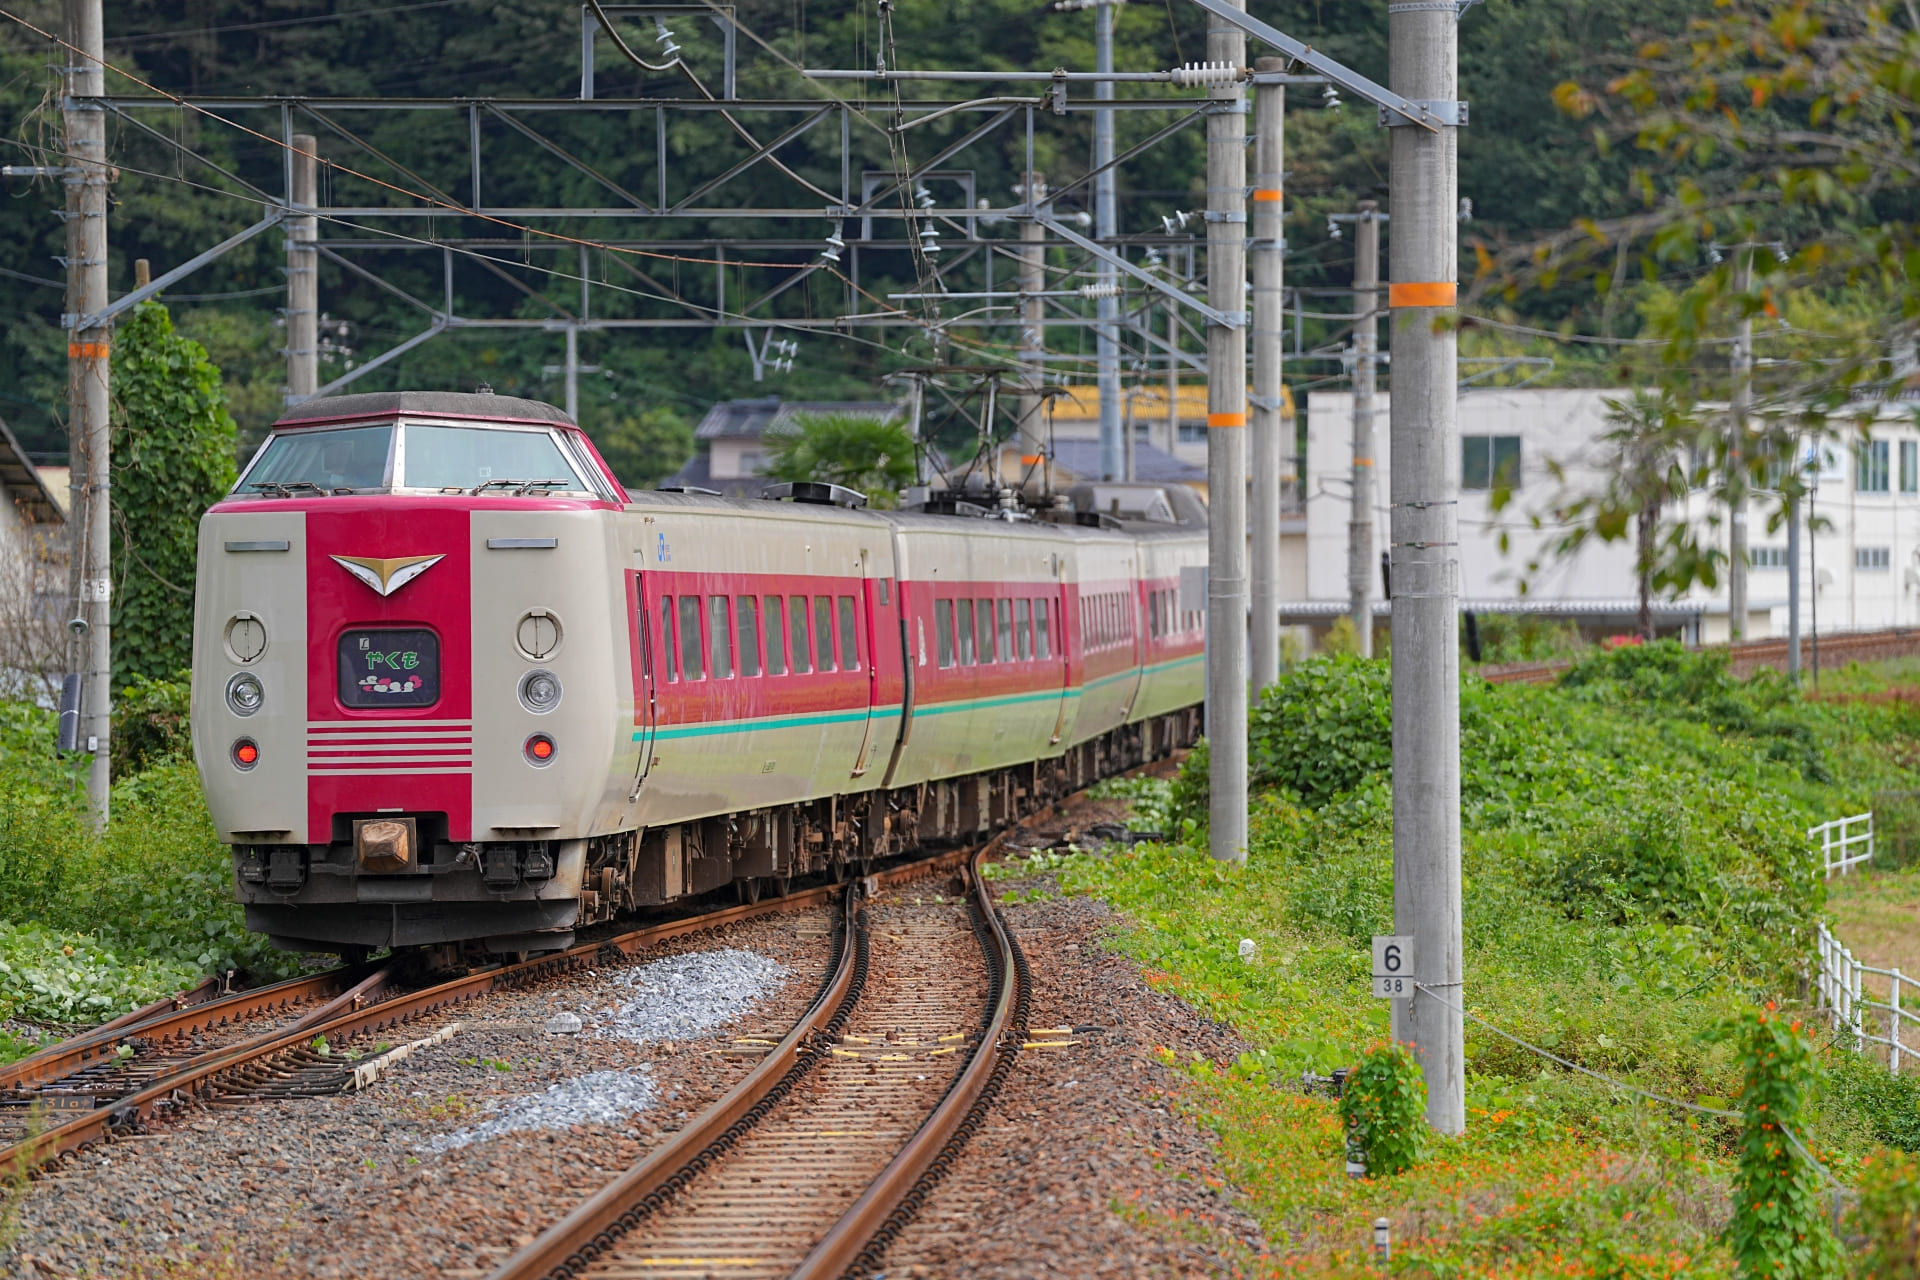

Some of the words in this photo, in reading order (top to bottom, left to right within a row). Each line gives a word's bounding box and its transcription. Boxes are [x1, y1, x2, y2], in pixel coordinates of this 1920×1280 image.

[366, 651, 420, 670] やくも
[1384, 945, 1401, 972] 6
[1383, 979, 1402, 992] 38
